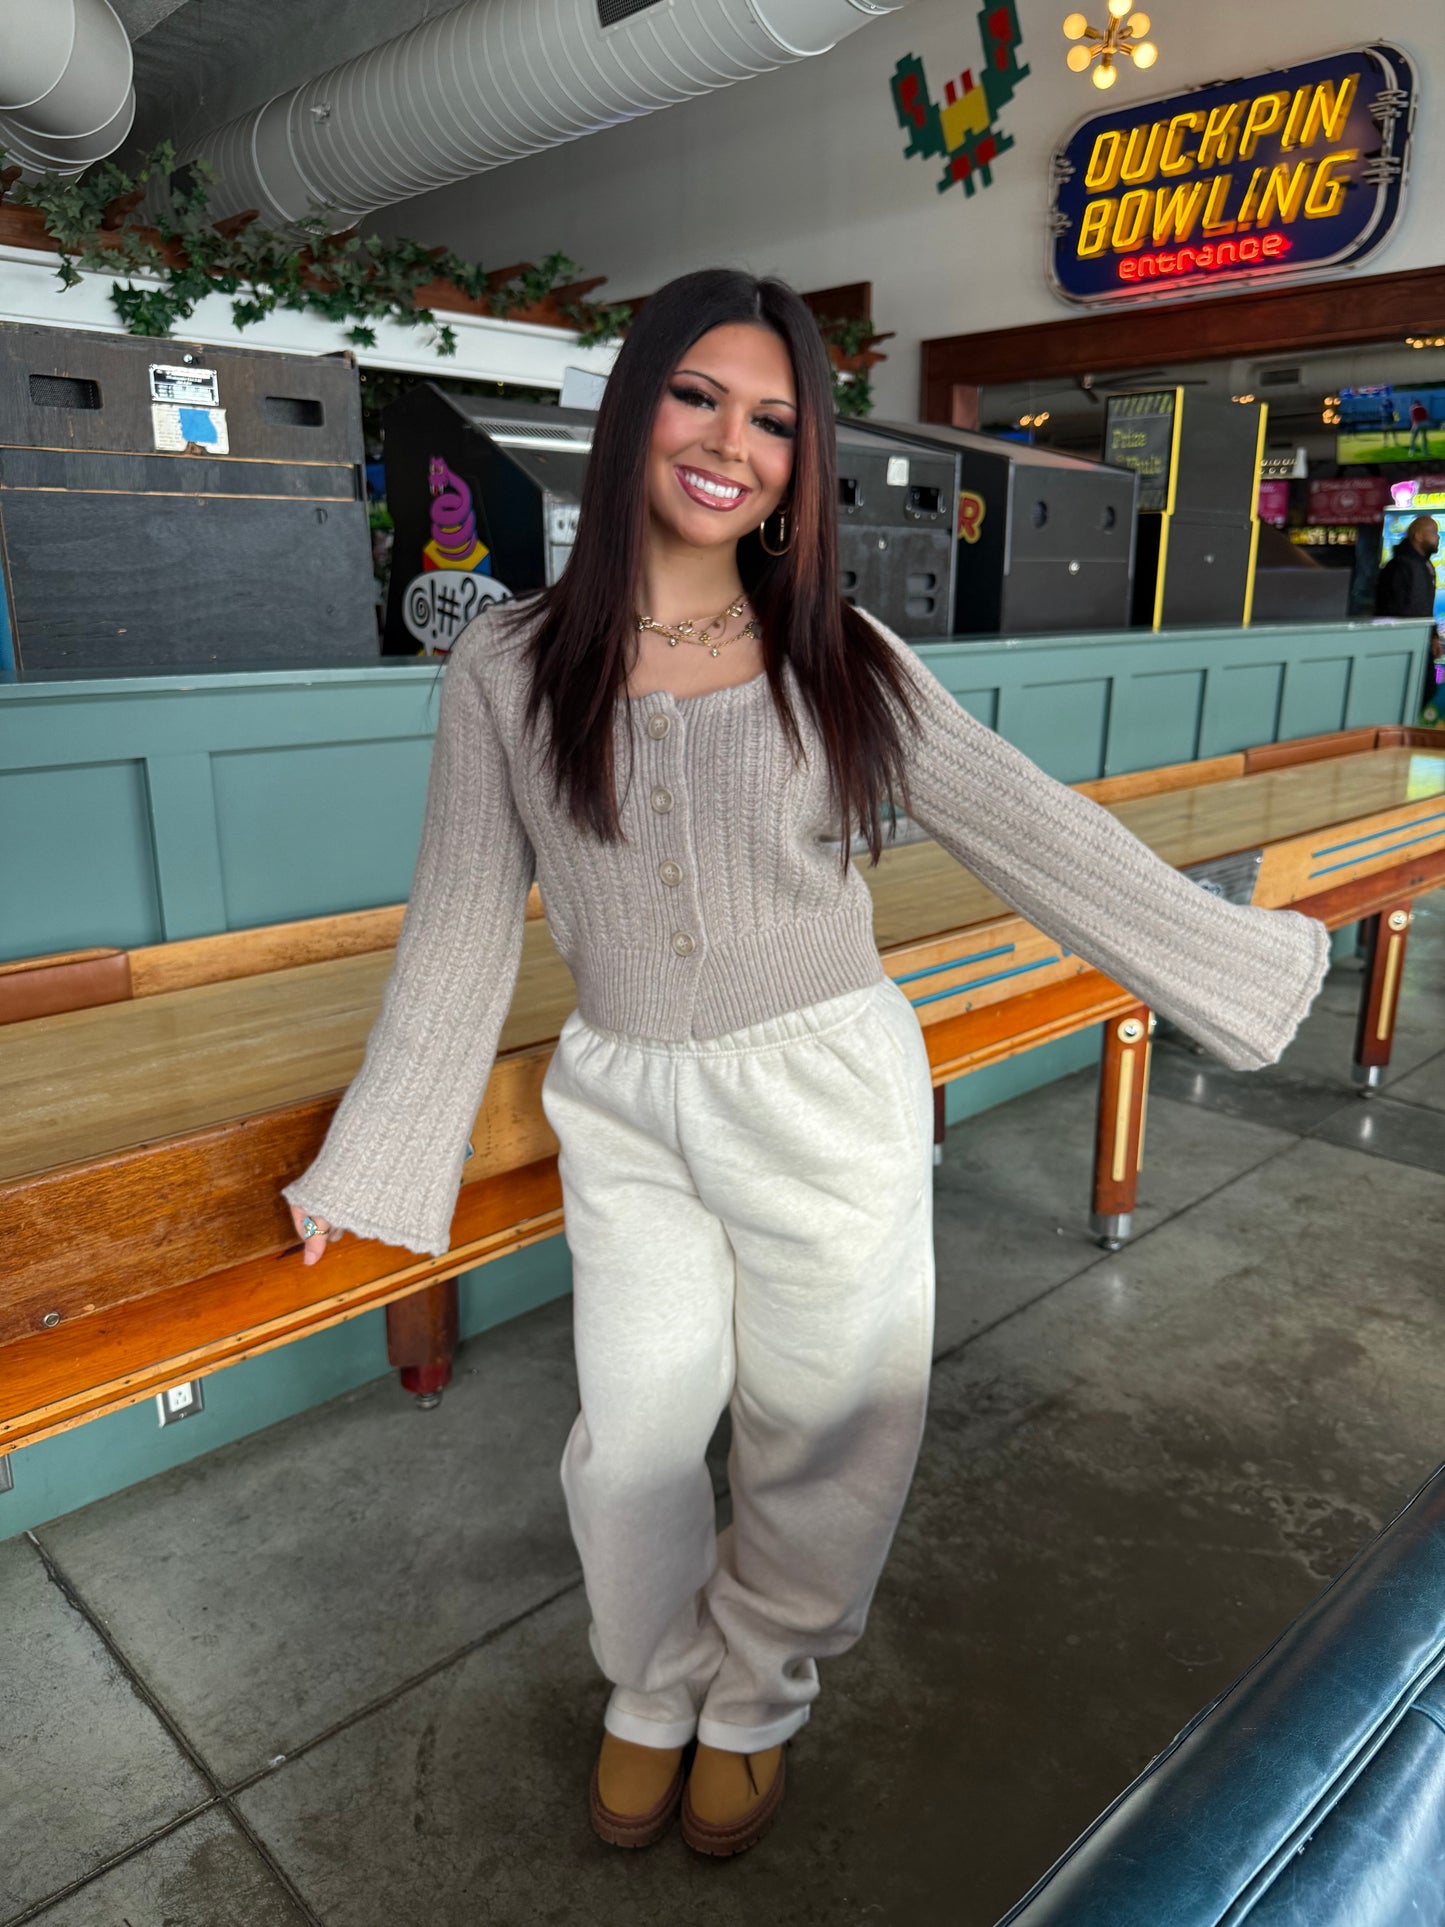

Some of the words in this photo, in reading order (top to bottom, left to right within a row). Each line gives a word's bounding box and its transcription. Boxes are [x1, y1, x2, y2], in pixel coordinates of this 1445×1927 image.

[1084, 74, 1360, 193] DUCKPIN
[1077, 150, 1358, 260] BOWLING
[1118, 233, 1290, 281] entrance
